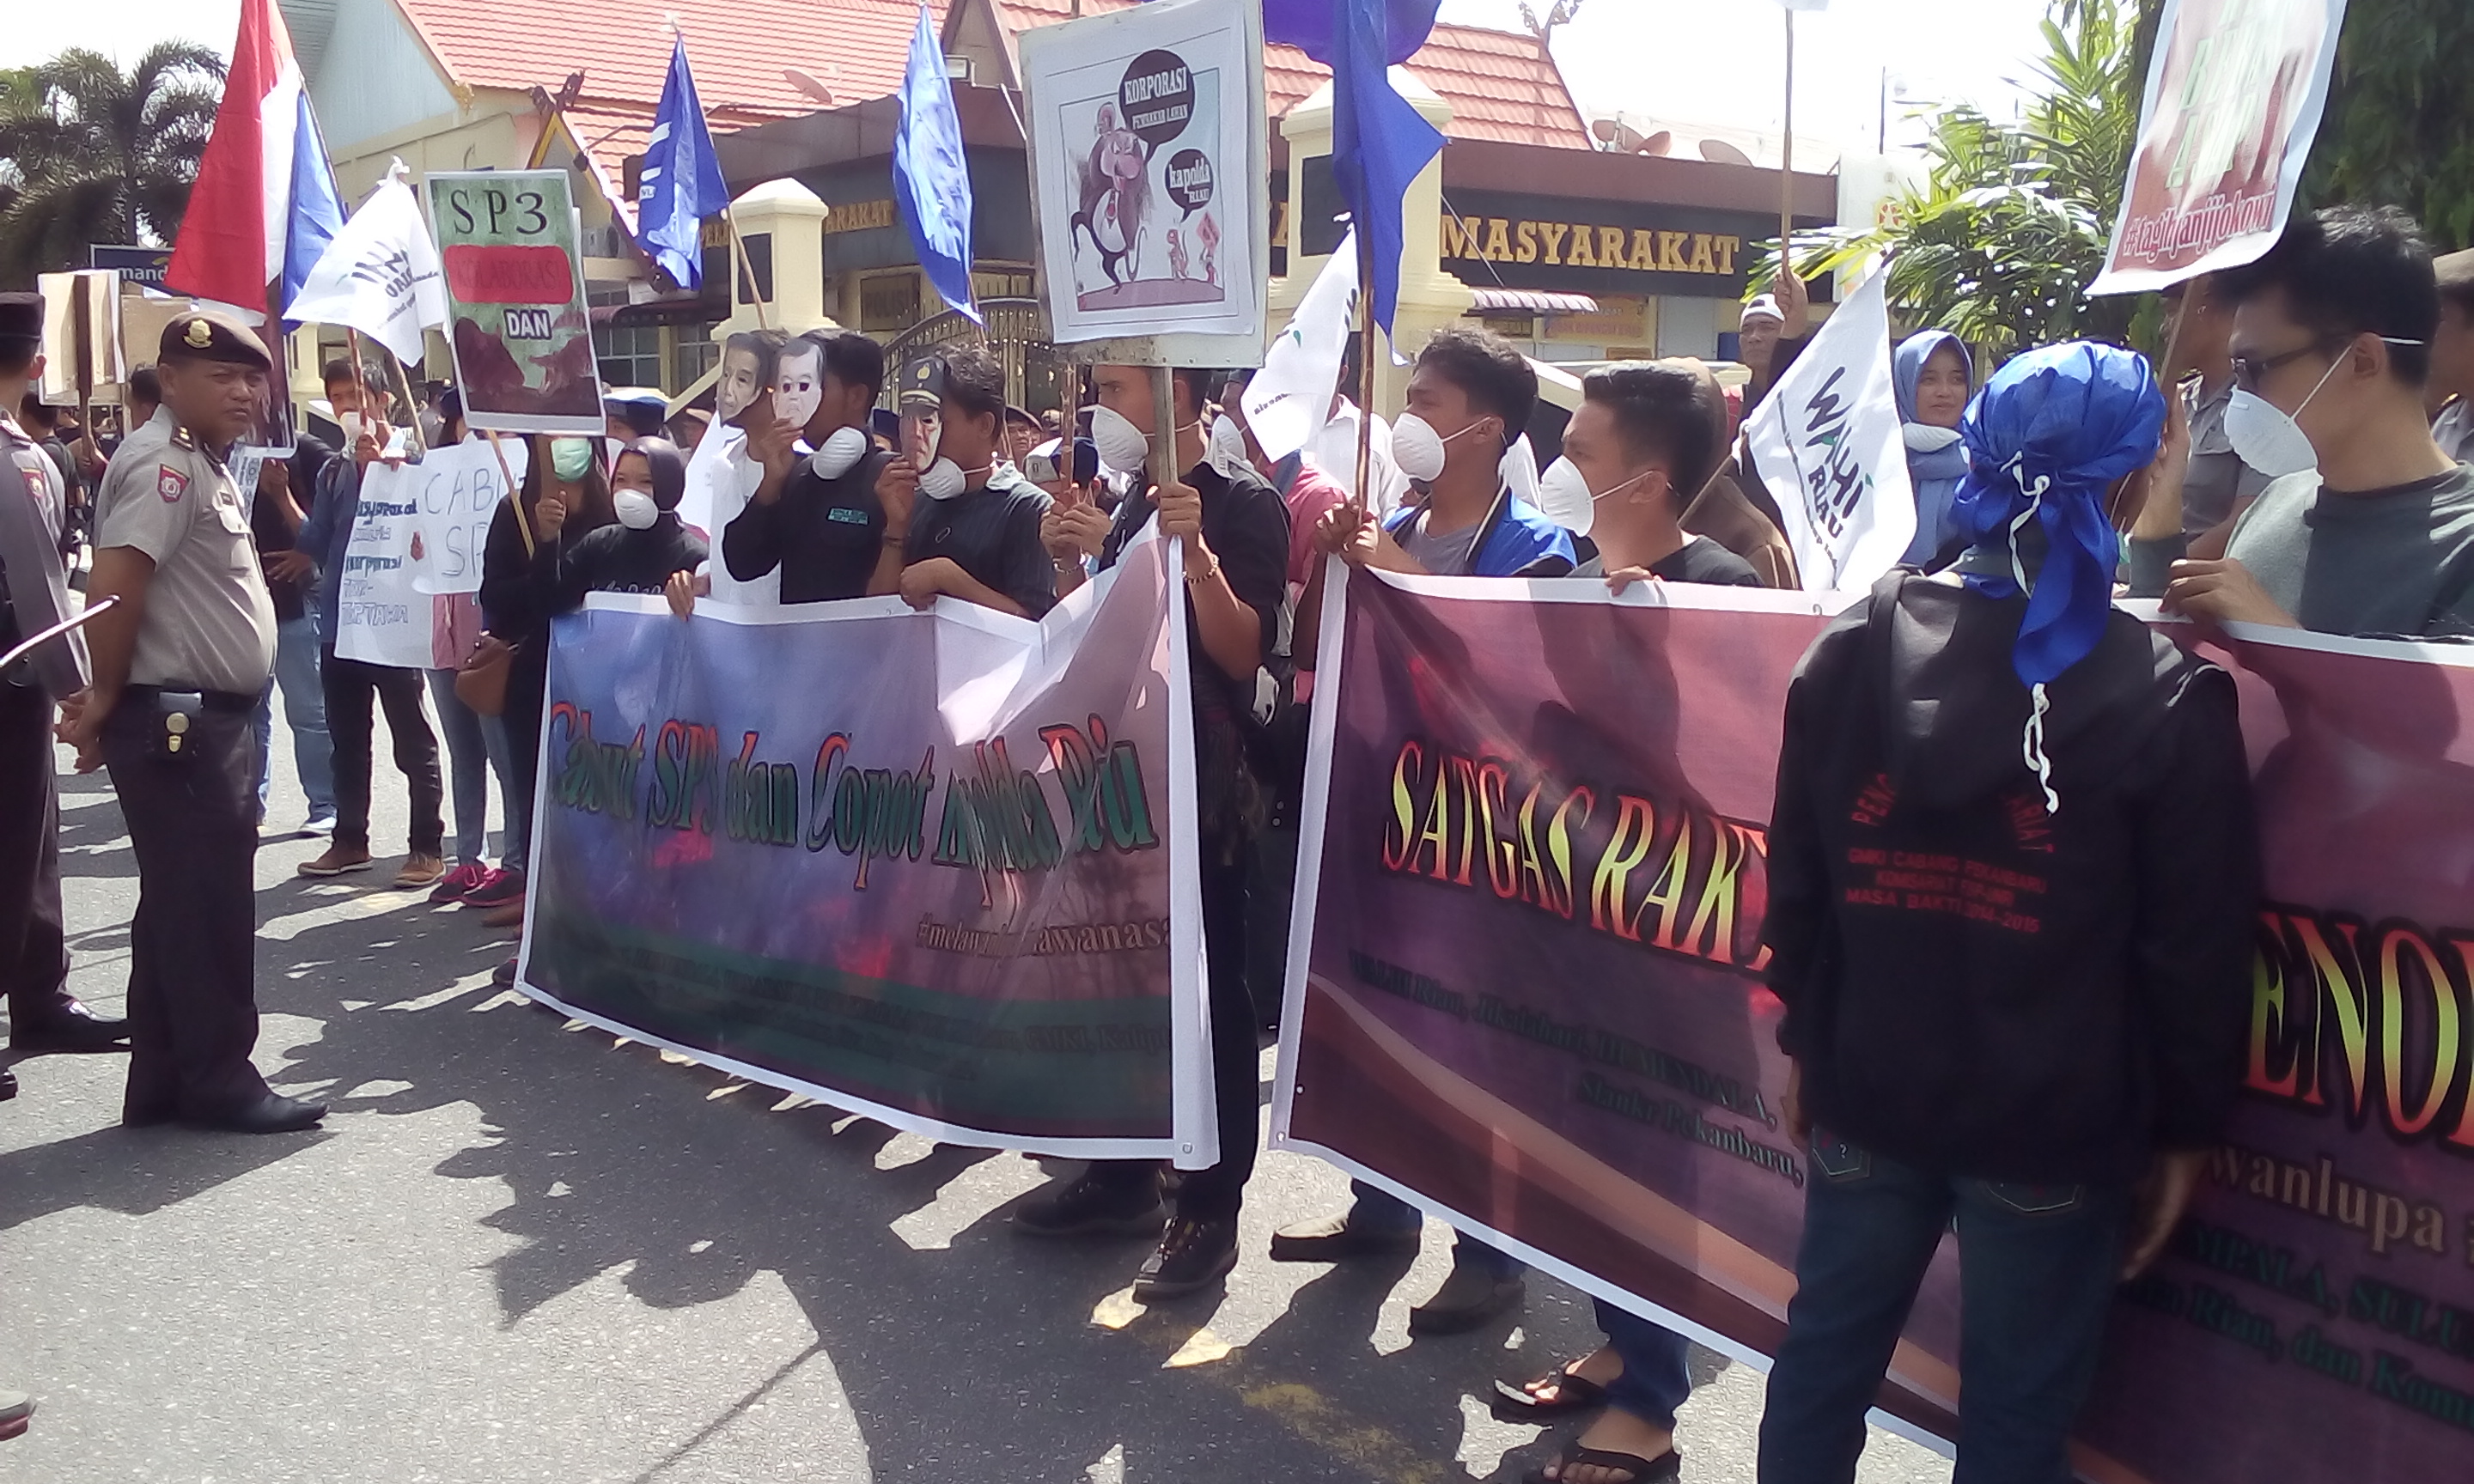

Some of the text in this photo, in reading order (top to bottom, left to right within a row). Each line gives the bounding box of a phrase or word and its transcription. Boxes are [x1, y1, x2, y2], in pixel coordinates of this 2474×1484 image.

[1124, 66, 1187, 105] KORPORASI
[1169, 157, 1210, 194] kapolda
[1441, 215, 1740, 274] MASYARAKAT
[504, 309, 551, 340] DAN
[1808, 465, 1843, 538] RIAU
[726, 731, 798, 848] dan
[806, 731, 935, 891] Copot
[1383, 740, 1596, 920] SATGAS
[1892, 850, 1959, 872] CABANG
[1845, 888, 1899, 907] MASA
[1906, 893, 1963, 914] BAKTI
[1661, 1098, 1804, 1189] Pekanbaru,
[2291, 1324, 2362, 1386] dan
